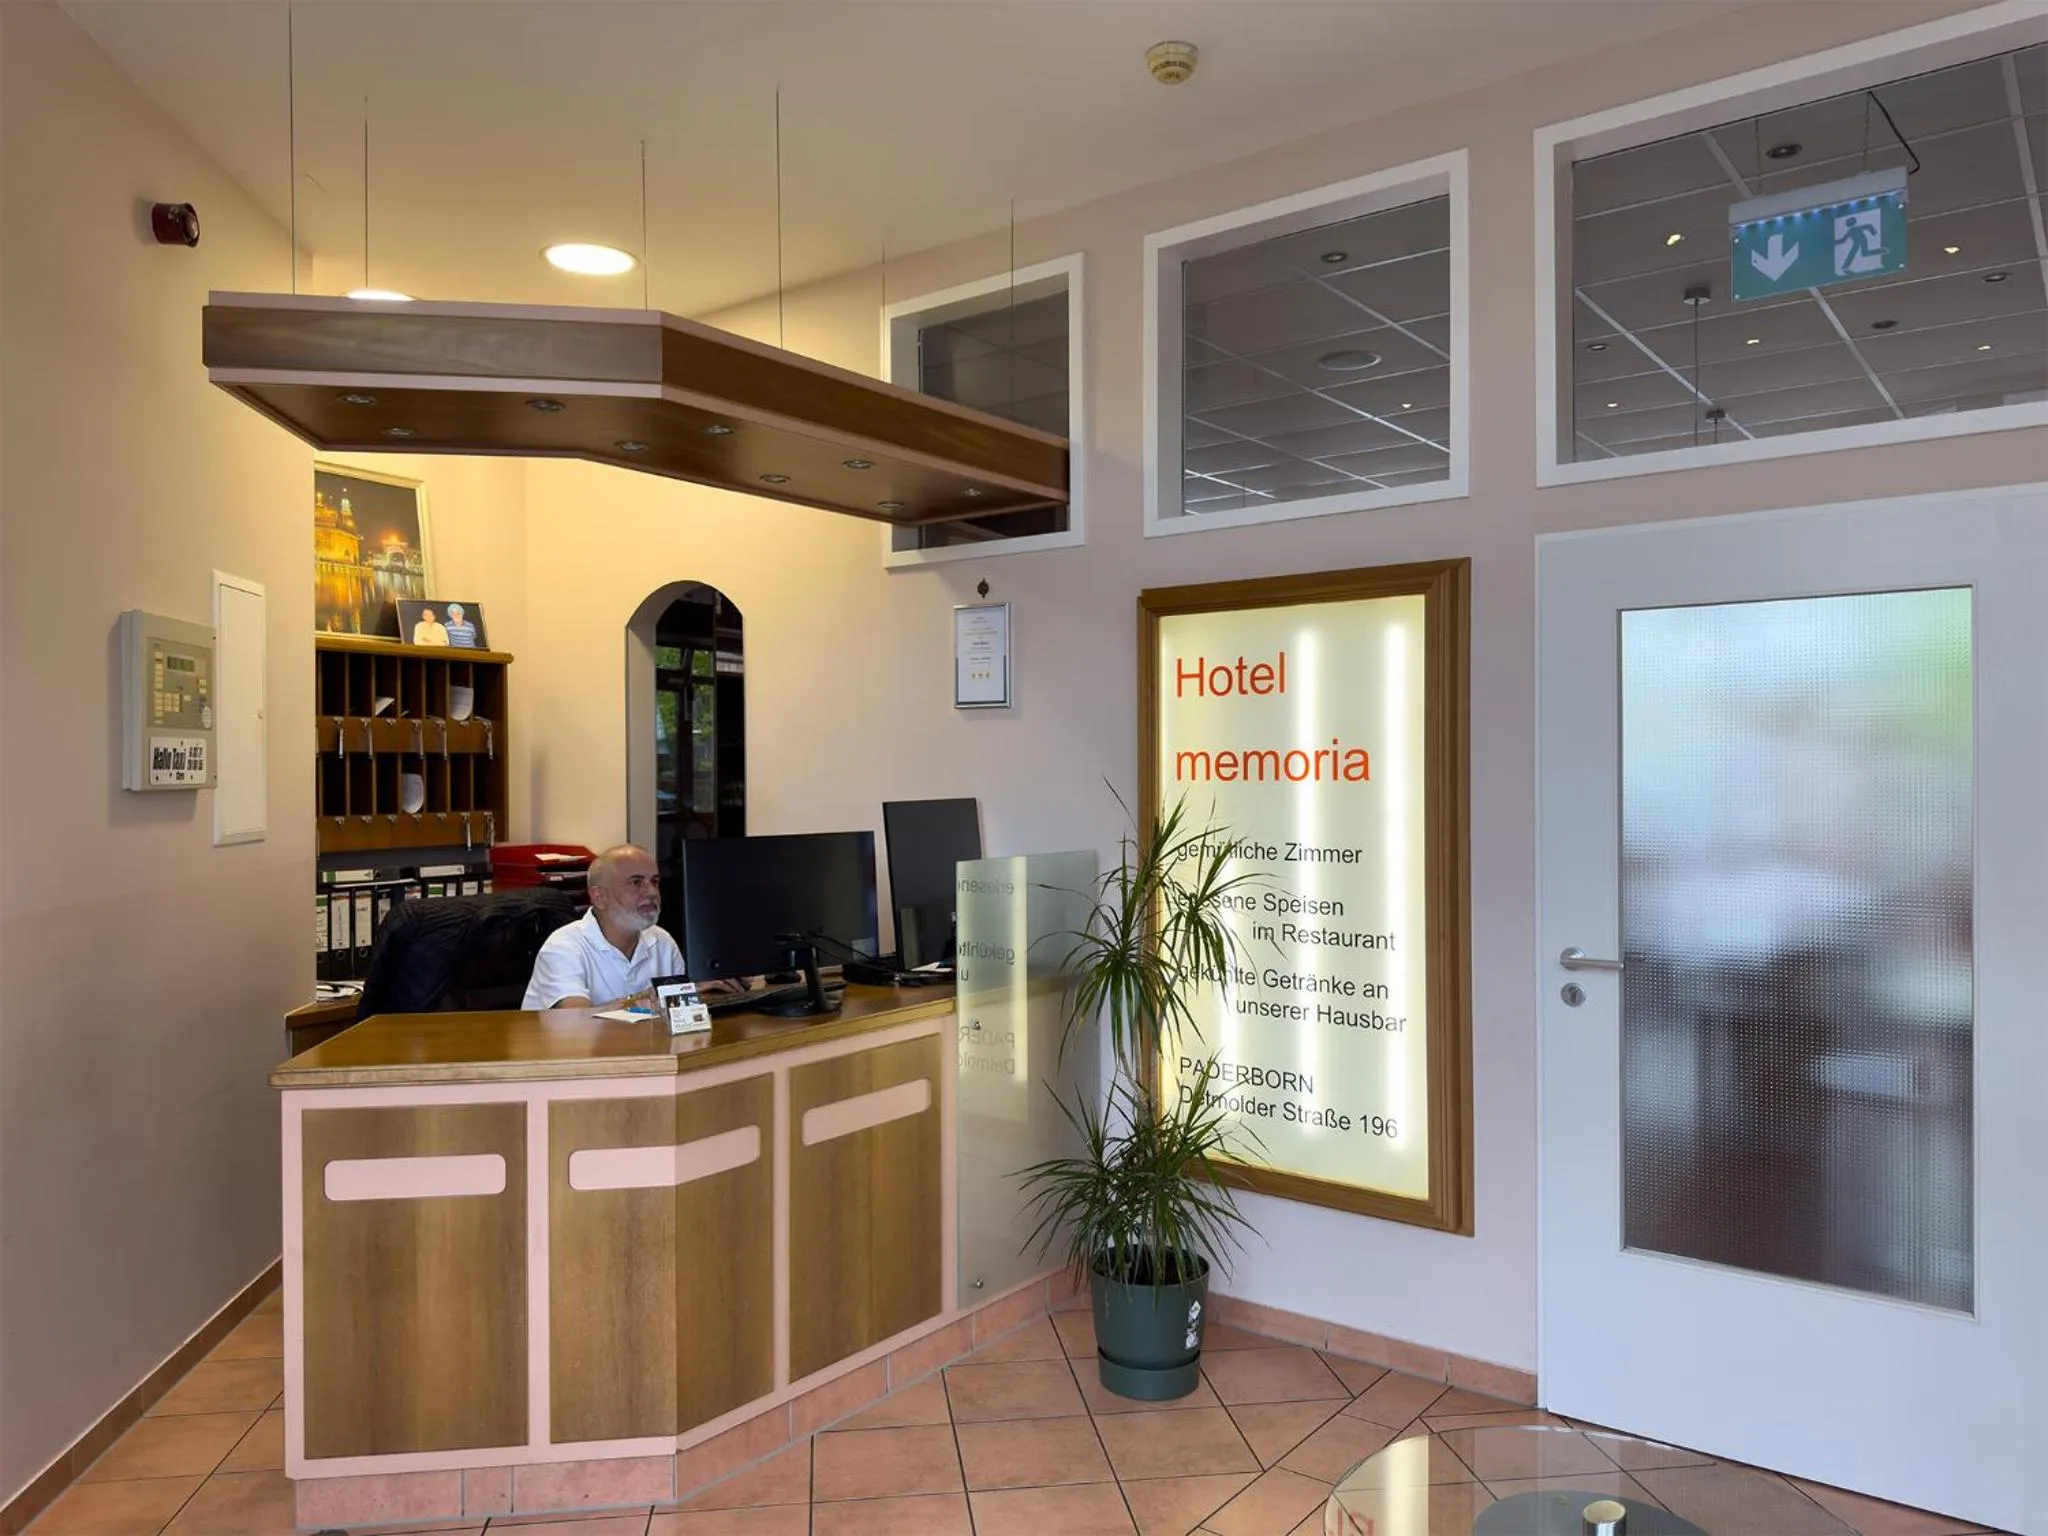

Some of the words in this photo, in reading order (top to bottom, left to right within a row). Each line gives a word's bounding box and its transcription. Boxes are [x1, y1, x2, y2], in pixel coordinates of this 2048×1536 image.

[1176, 652, 1286, 698] Hotel
[1176, 738, 1371, 782] memoria
[1284, 843, 1363, 863] Zimmer
[1178, 893, 1256, 911] esene
[1263, 893, 1344, 916] Speisen
[1252, 922, 1274, 941] im
[1282, 924, 1396, 950] Restaurant
[1263, 969, 1356, 996] Getränke
[1363, 984, 1389, 999] an
[1236, 1000, 1310, 1021] unserer
[1317, 1004, 1406, 1033] Hausbar
[1180, 1057, 1313, 1094] PADERBORN
[1180, 1085, 1278, 1117] Dtmolder
[1283, 1101, 1351, 1132] Straße
[1359, 1113, 1399, 1140] 196
